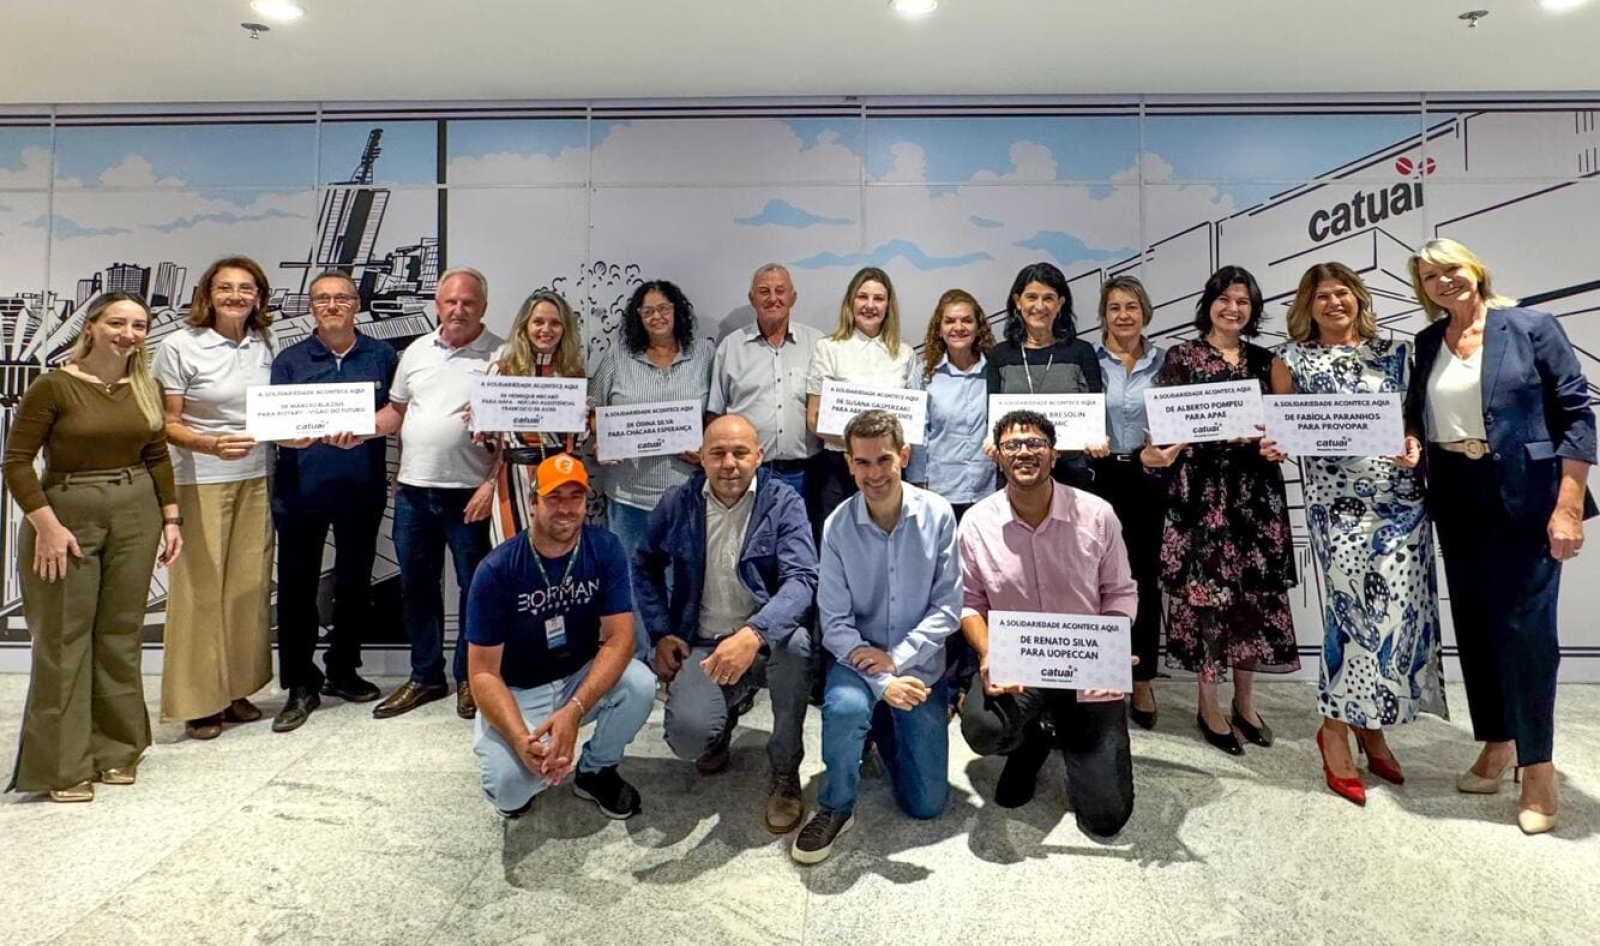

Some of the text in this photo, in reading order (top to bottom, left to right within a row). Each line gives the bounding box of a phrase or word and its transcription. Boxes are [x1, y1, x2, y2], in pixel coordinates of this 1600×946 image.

[836, 388, 875, 397] SOLIDARIEDADE
[878, 392, 904, 400] ACONTECE
[1159, 391, 1203, 400] SOLIDARIEDADE
[1205, 388, 1235, 396] ACONTECE
[846, 399, 870, 408] SUSANA
[1177, 403, 1210, 412] ALBERTO
[1212, 400, 1244, 409] POMPEU
[610, 409, 651, 417] SOLIDARIEDADE
[653, 406, 679, 414] ACONTECE
[1297, 412, 1331, 421] FABÍOLA
[626, 428, 656, 436] CHÁCARA
[658, 425, 692, 433] ESPERANÇA
[1007, 620, 1060, 629] SOLIDARIEDADE
[1062, 623, 1099, 631] ACONTECE
[1101, 624, 1119, 633] AQUI
[1020, 636, 1099, 648] DE RENATO SILVA
[1020, 648, 1099, 660] PARA UOPECCAN
